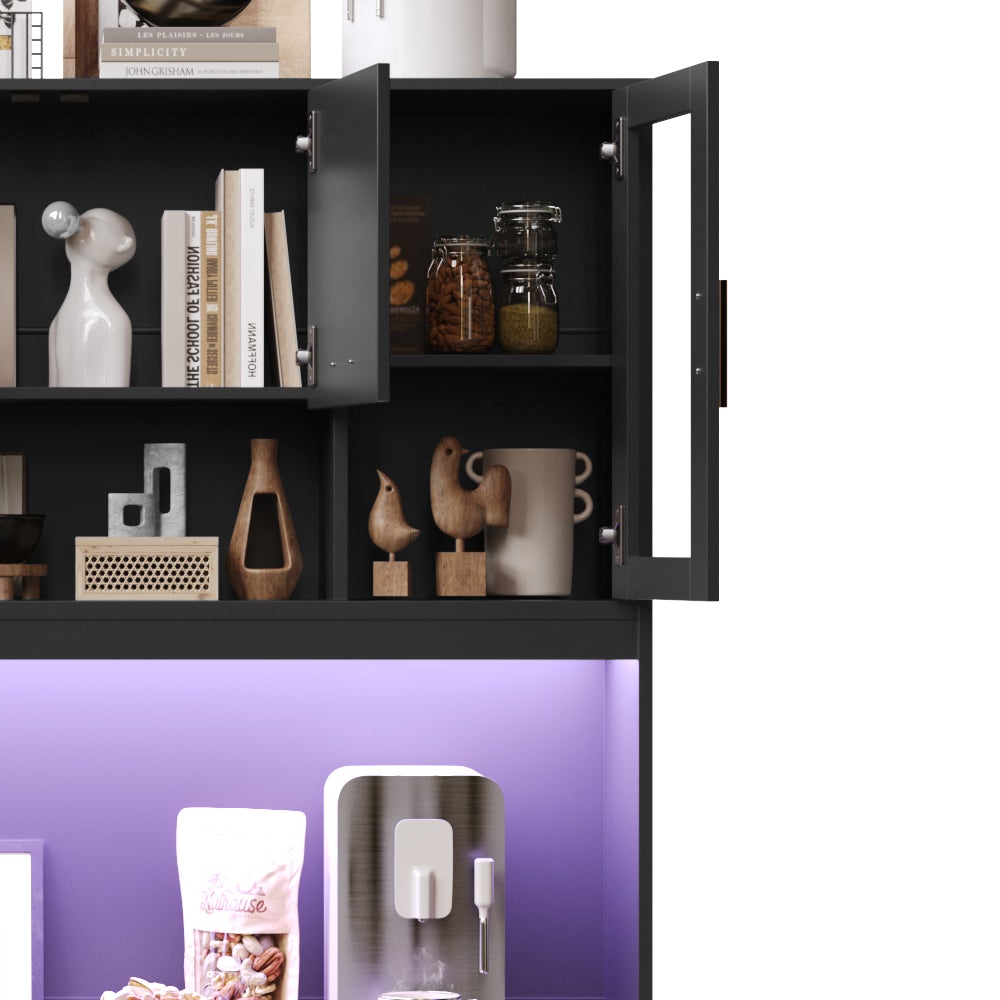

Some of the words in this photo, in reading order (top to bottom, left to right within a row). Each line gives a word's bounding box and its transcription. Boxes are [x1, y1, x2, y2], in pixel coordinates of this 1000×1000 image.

[137, 31, 153, 39] LES
[156, 31, 197, 39] PLAISIRS
[110, 47, 187, 57] SIMPLICITY
